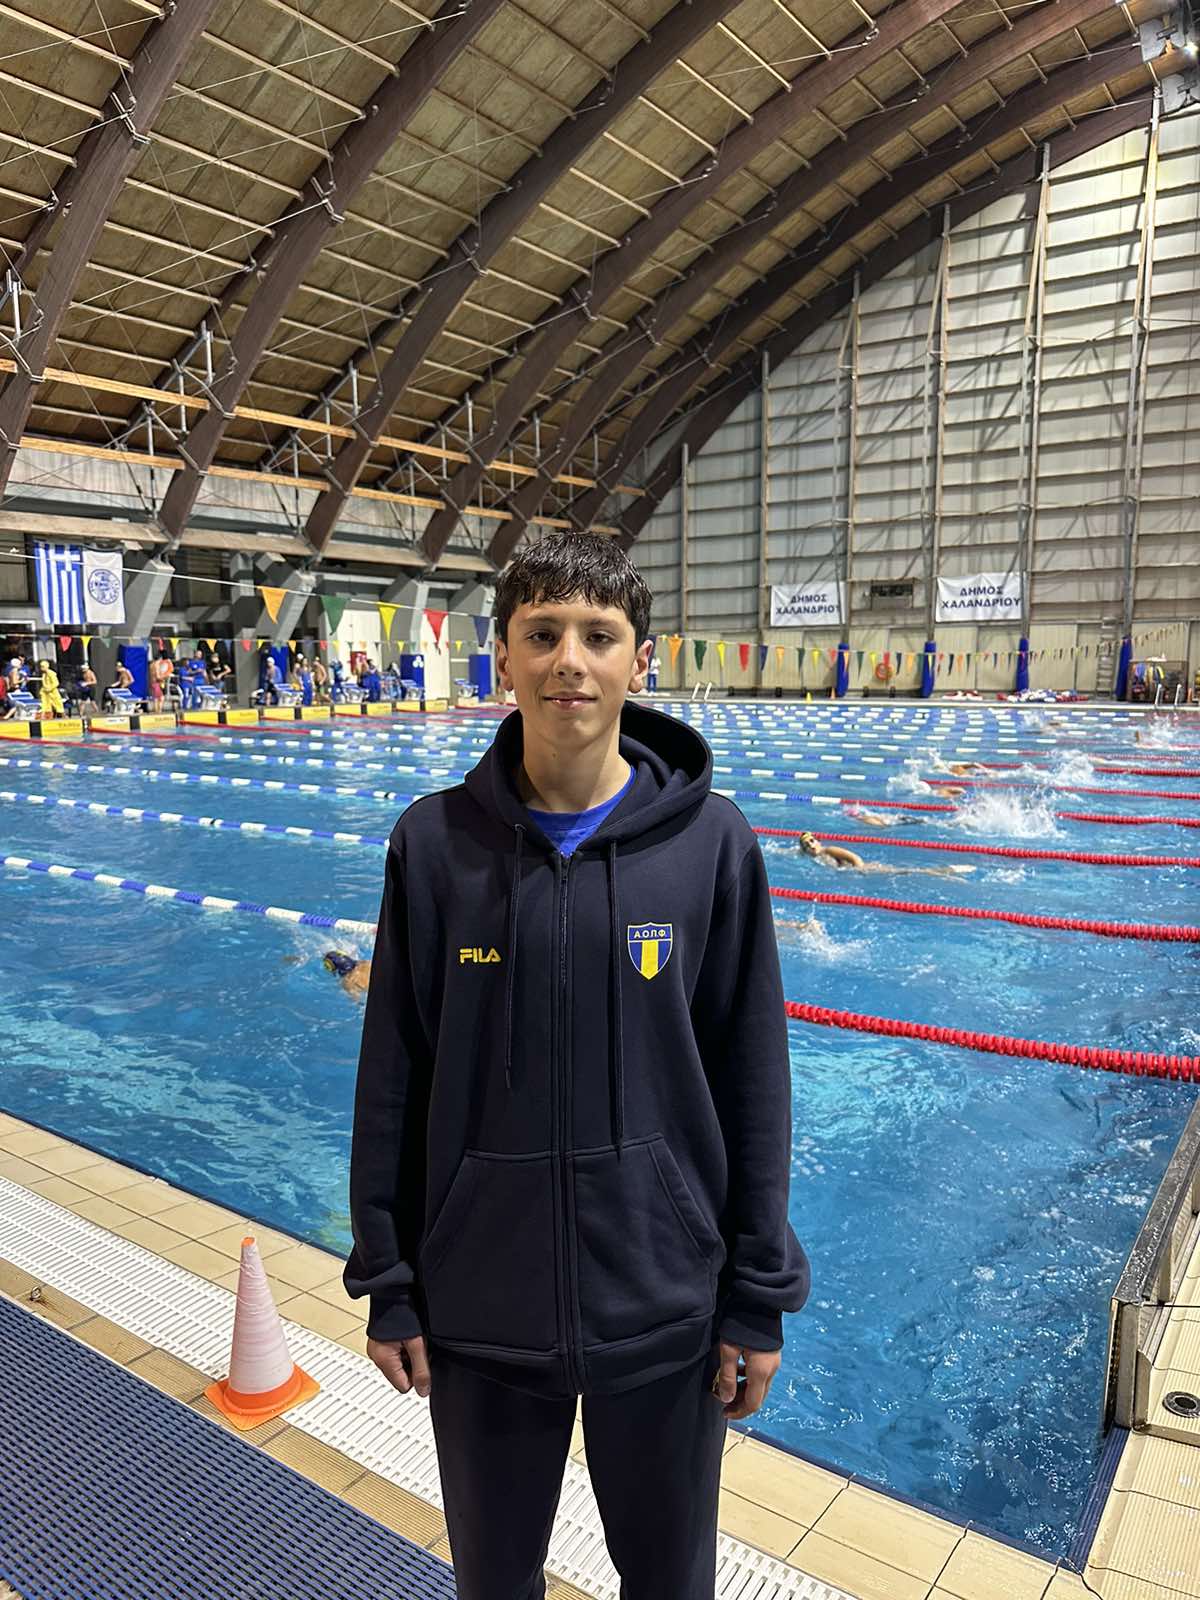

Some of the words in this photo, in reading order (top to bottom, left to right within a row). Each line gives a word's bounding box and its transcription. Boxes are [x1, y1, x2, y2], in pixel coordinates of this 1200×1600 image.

[960, 585, 1004, 597] ΔΗΜΟΣ
[790, 593, 828, 604] ΔΗΜΟΣ
[942, 597, 1021, 609] ΧΑΛΑΝΔΡΙΟΥ
[459, 947, 502, 964] FILA
